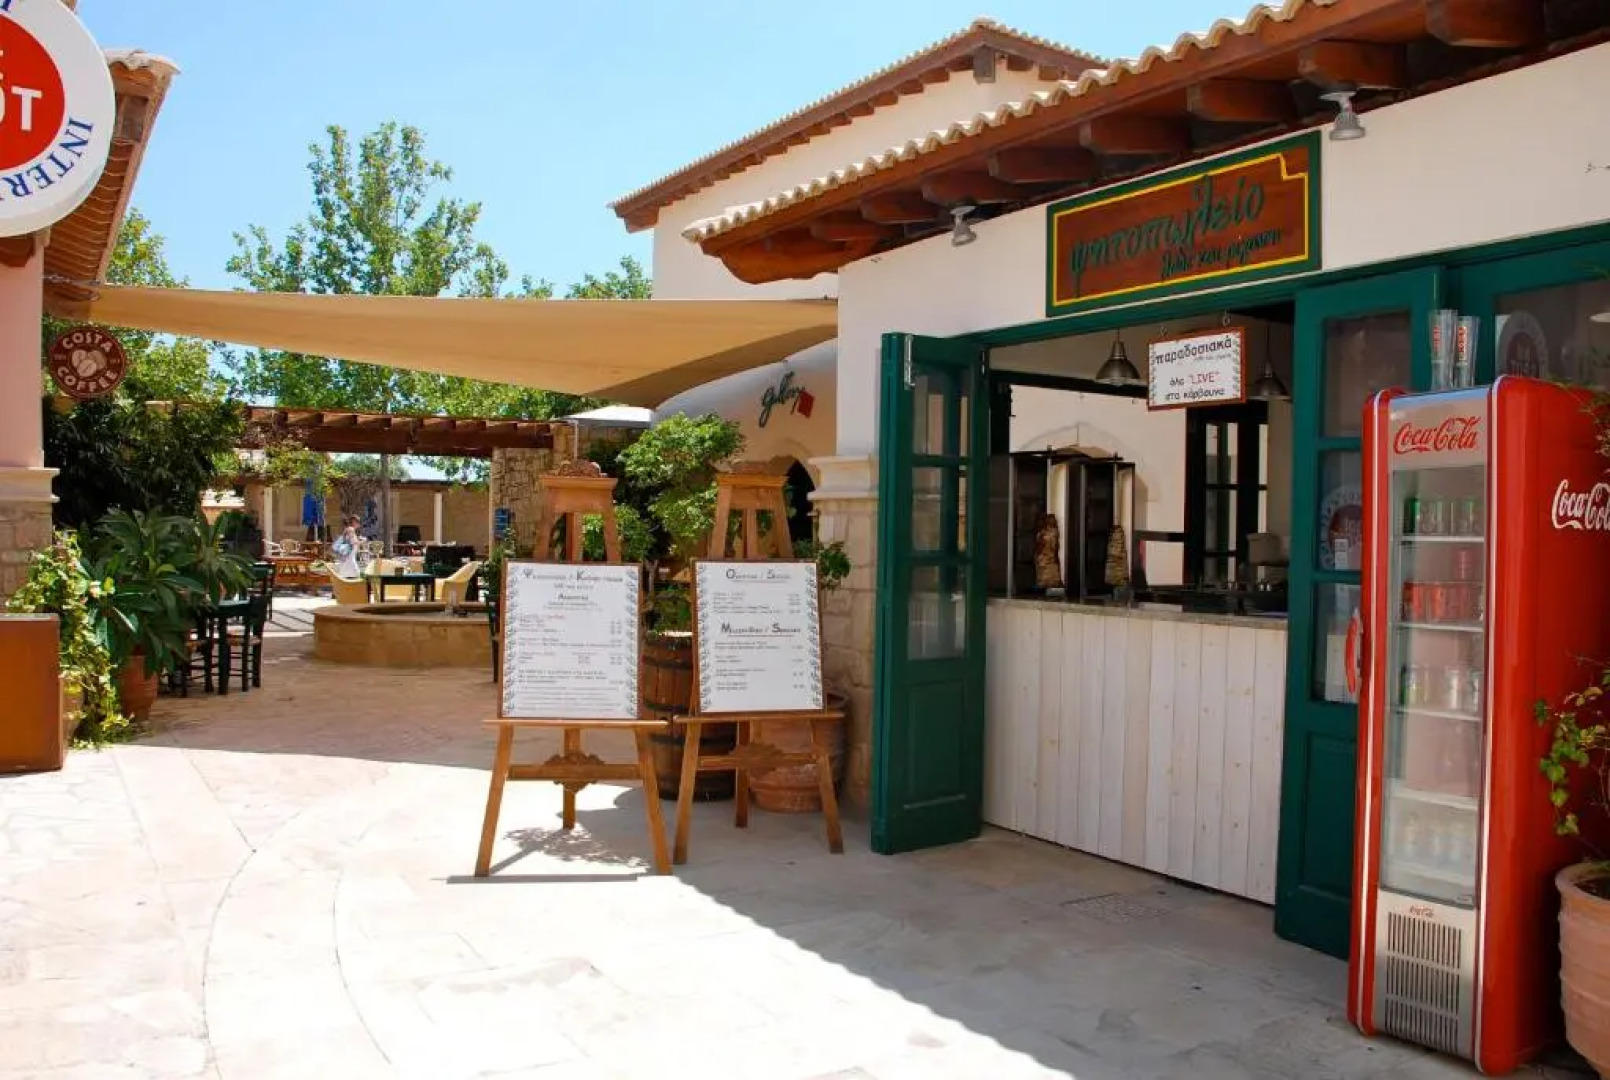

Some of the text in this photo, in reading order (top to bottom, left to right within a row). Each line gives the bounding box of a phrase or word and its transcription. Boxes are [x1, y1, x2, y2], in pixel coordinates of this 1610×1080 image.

[0, 82, 43, 132] T
[0, 117, 94, 200] INTER
[62, 331, 113, 353] COSTA
[1155, 334, 1232, 365] παραδοσιακά
[57, 365, 118, 392] COFFEE
[1393, 415, 1481, 454] Coca-Cola
[1551, 478, 1610, 530] Coca-Col
